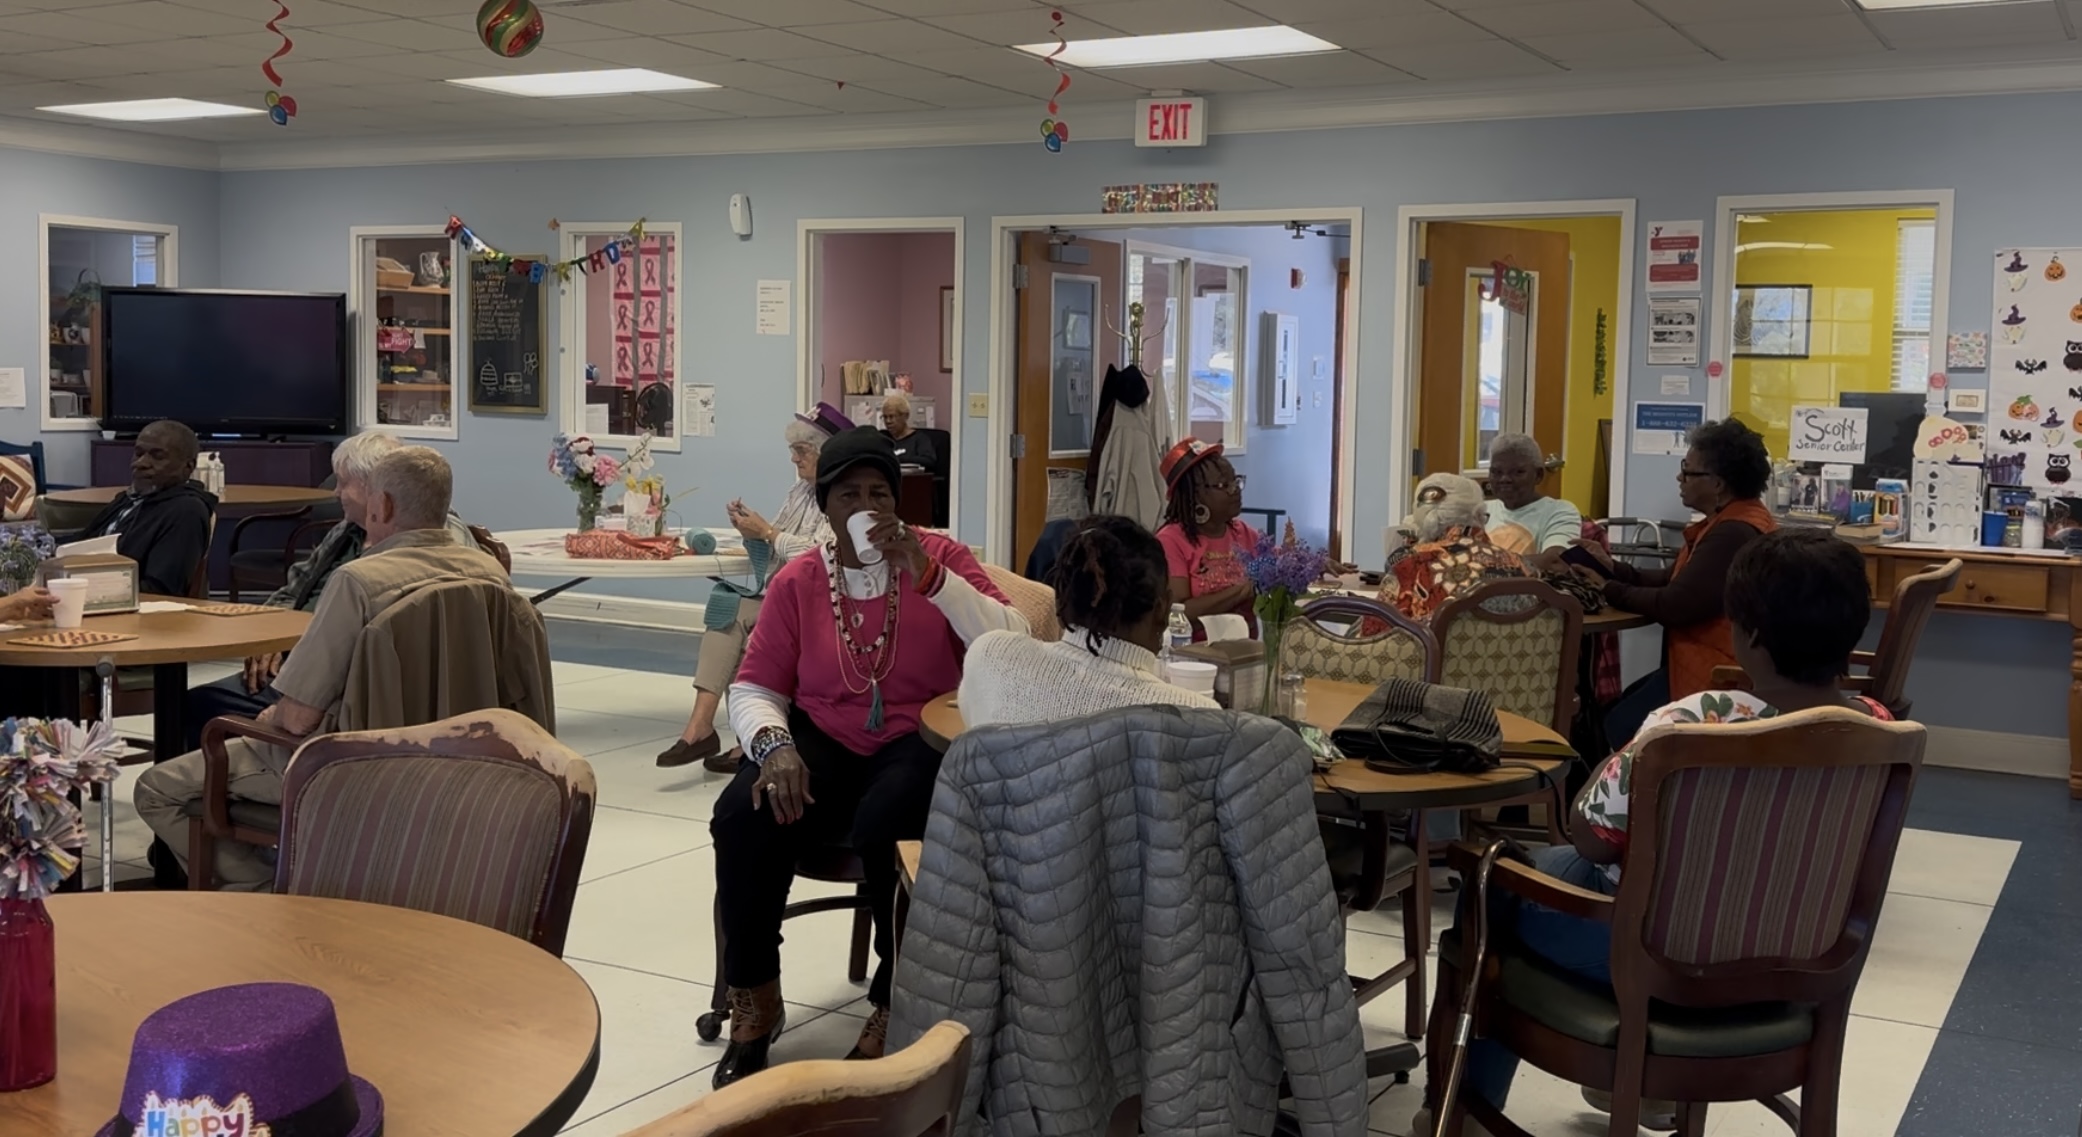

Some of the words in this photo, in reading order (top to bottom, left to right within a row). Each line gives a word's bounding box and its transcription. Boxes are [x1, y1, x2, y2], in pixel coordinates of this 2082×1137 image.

[1149, 103, 1192, 140] EXIT
[1805, 414, 1857, 442] Scott
[1796, 439, 1831, 450] Senior
[1833, 438, 1865, 452] Center
[147, 1110, 244, 1137] Happy
